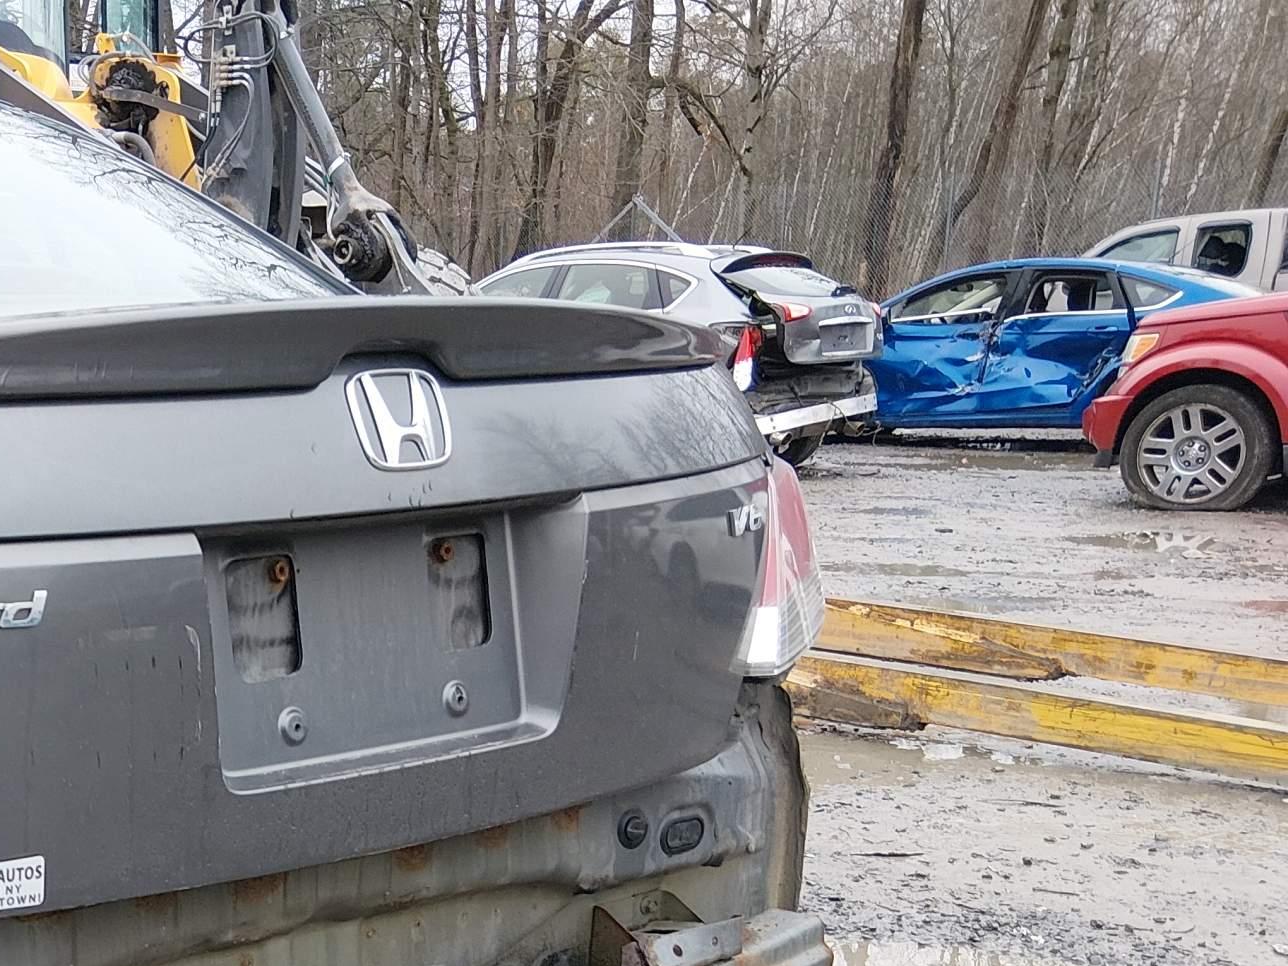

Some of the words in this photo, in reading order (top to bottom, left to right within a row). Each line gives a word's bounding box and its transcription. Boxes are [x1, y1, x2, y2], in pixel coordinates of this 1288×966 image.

[726, 503, 763, 537] V6
[5, 884, 23, 895] NY
[0, 894, 42, 908] TOWN!
